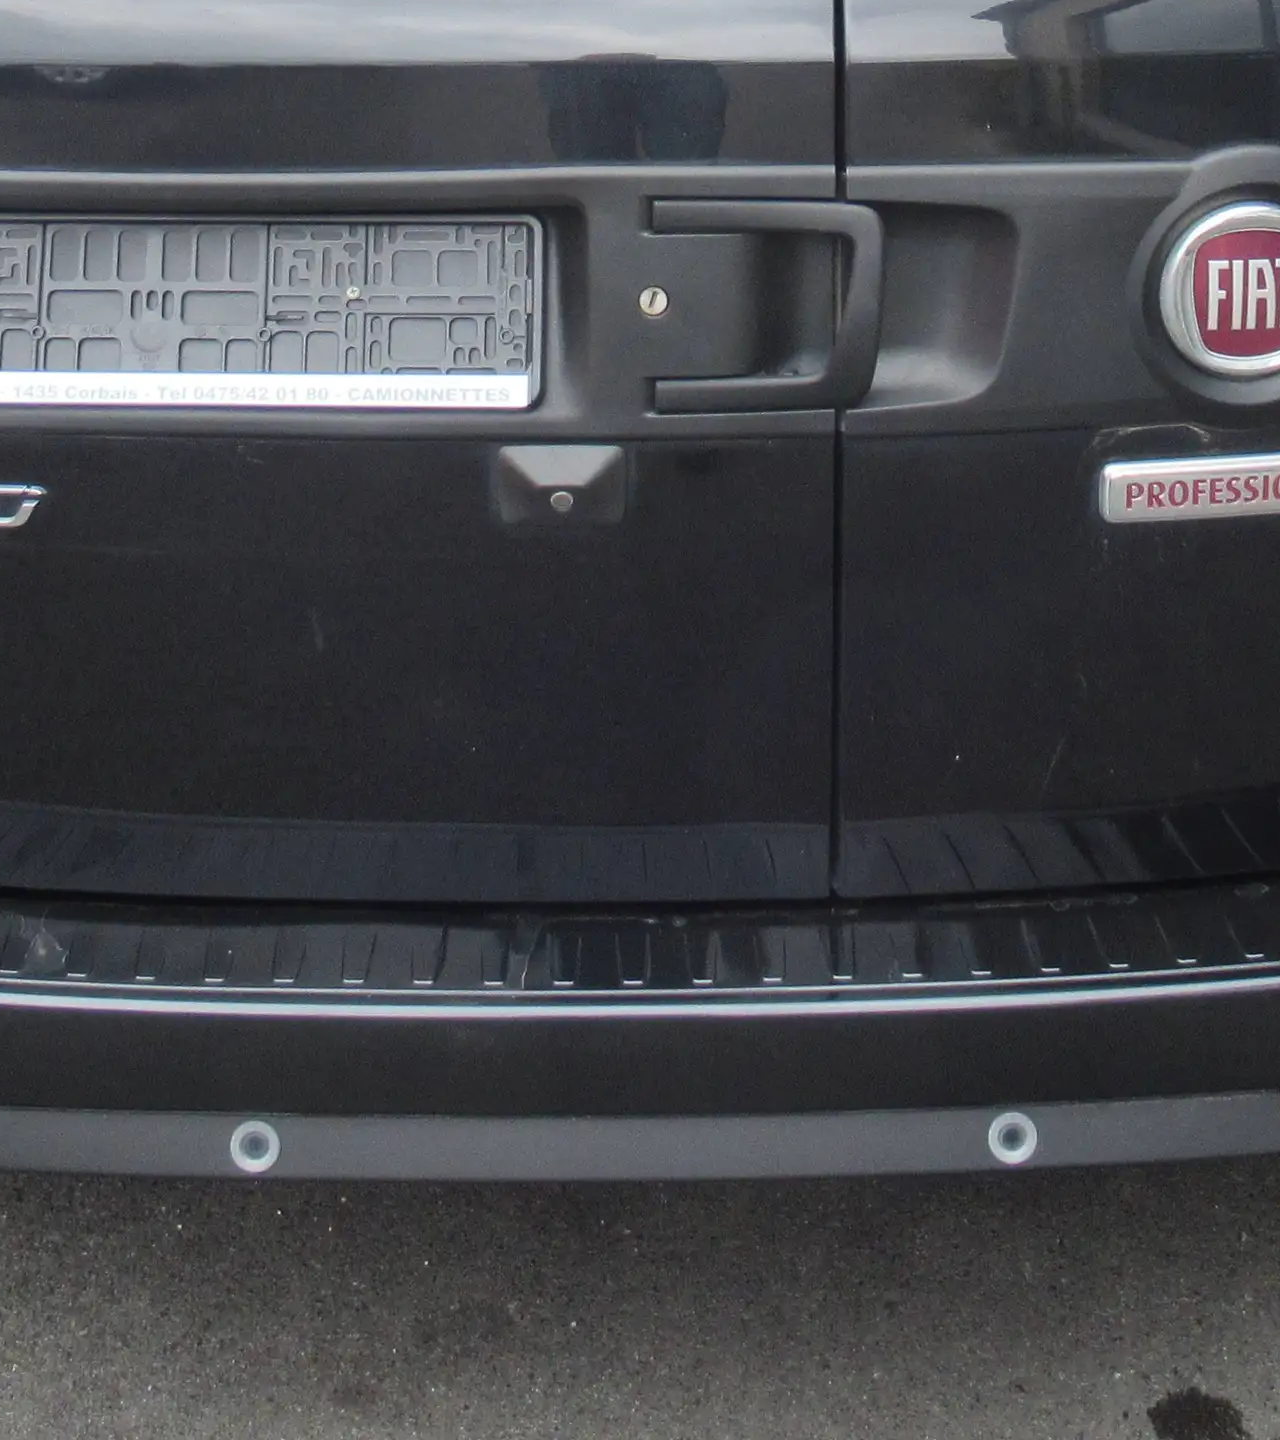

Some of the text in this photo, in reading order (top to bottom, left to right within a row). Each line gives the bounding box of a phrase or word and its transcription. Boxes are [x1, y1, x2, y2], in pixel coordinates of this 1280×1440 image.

[12, 386, 58, 399] 1435
[65, 386, 138, 401] Corbais
[158, 386, 186, 401] Tel
[194, 386, 269, 401] 0475/42
[348, 387, 511, 404] CAMIONNETTES
